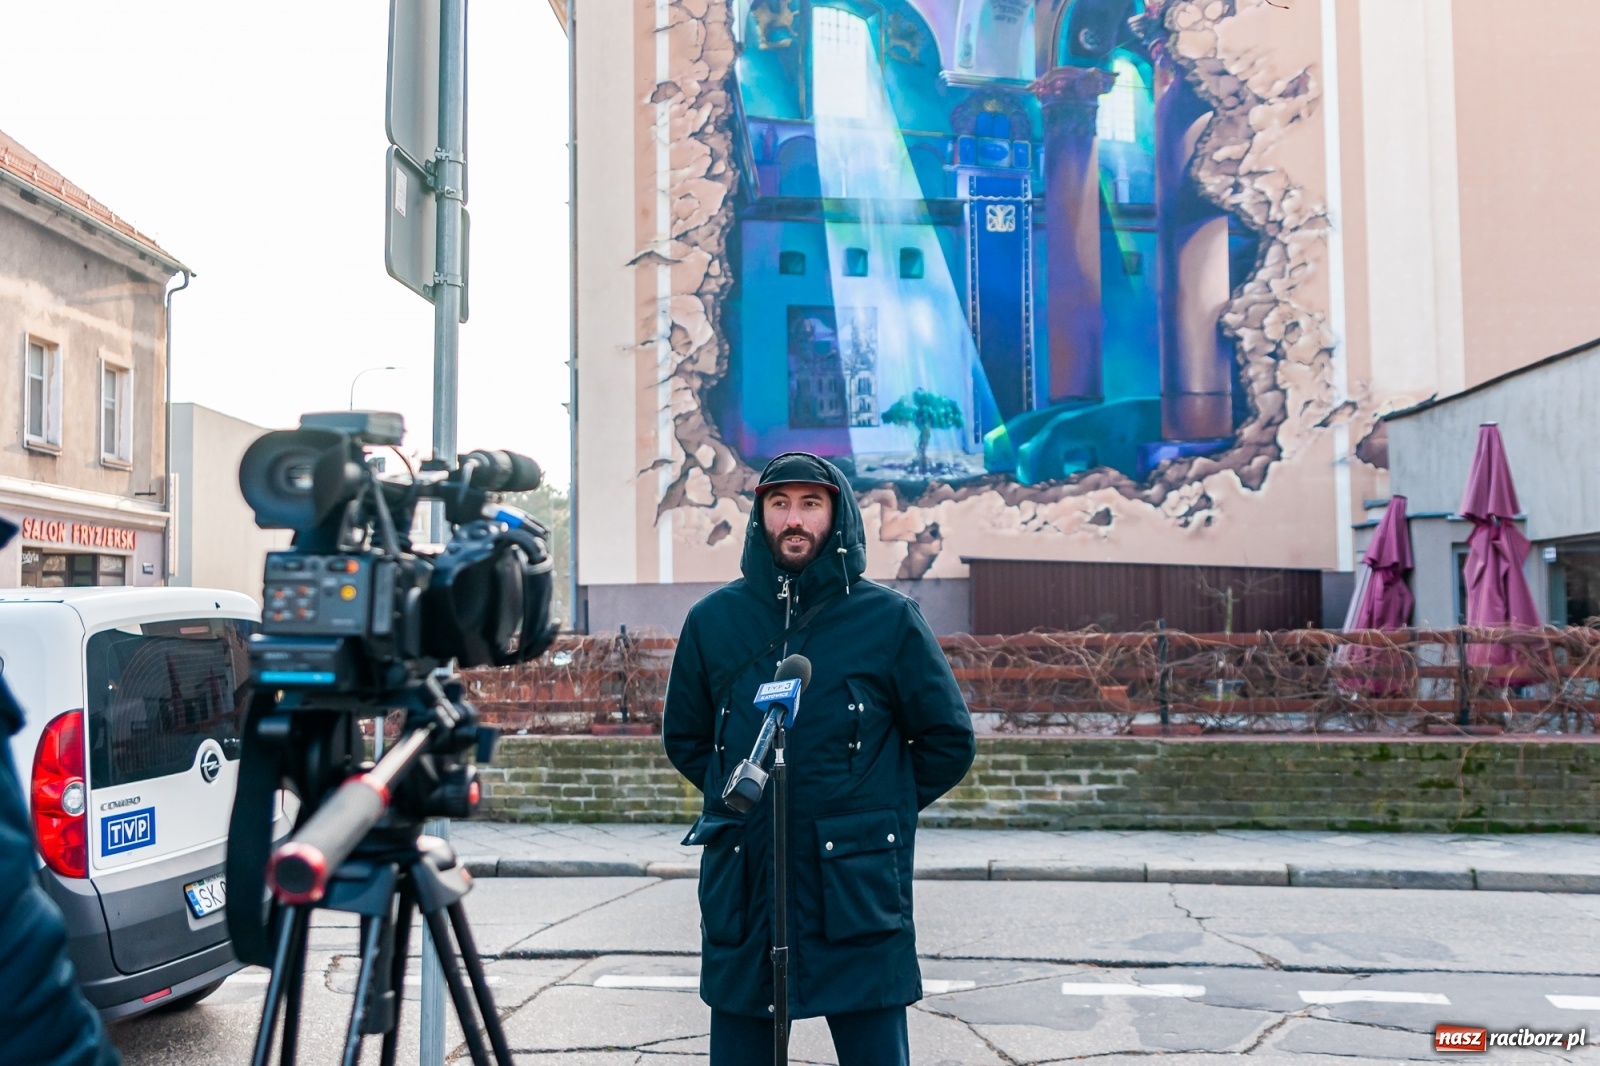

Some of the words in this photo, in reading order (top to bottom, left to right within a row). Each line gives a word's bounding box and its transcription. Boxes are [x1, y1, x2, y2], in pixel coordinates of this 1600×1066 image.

[22, 517, 66, 543] SALON
[72, 524, 137, 550] FRYZJERSKI
[100, 796, 141, 811] COMBO
[110, 819, 147, 844] TVP
